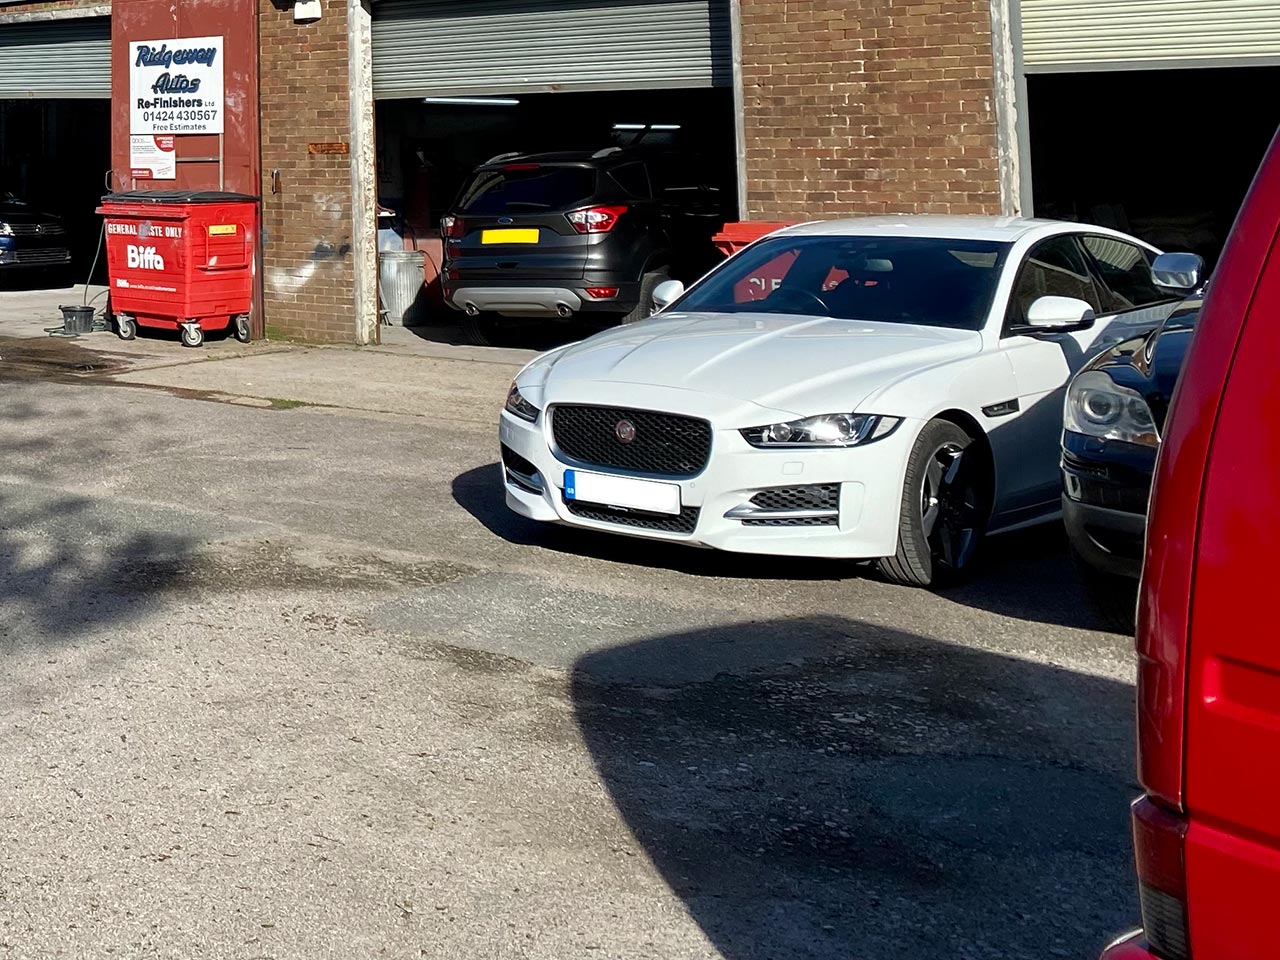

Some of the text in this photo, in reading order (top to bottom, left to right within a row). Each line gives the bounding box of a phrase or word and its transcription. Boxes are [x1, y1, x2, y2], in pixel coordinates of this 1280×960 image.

[135, 44, 217, 69] Ridgeway
[151, 72, 201, 94] Autos
[137, 97, 203, 109] Re-Finishers
[143, 110, 218, 122] 01424 430567
[169, 123, 207, 131] Estimates
[108, 223, 138, 235] GENERAL
[165, 226, 182, 238] ONLY
[127, 244, 164, 270] Biffa
